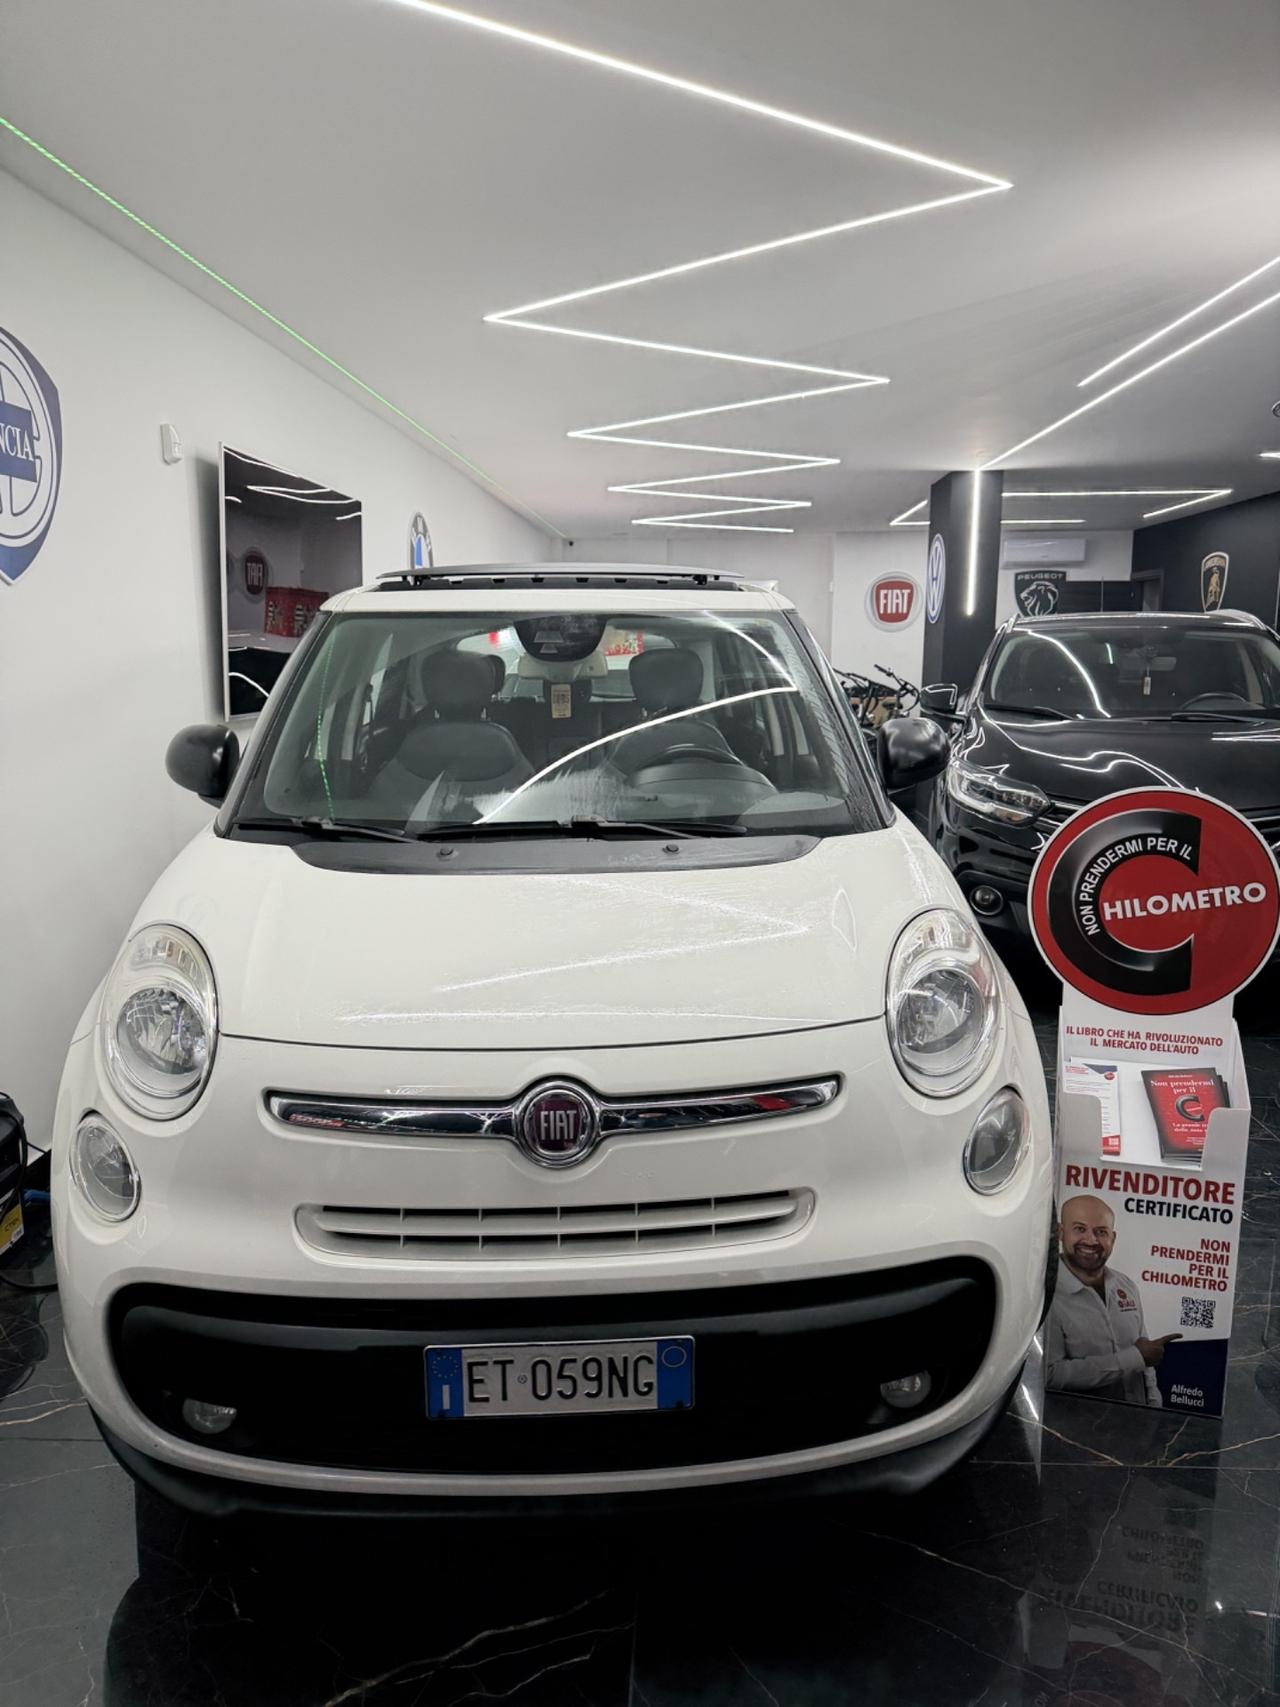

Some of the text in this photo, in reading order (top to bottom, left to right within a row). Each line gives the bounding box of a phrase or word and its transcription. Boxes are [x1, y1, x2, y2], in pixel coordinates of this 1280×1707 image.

[880, 589, 911, 614] FIAT
[1079, 837, 1193, 936] NON PRENDERMI PER IL
[1066, 1026, 1223, 1047] IL LIBRO CHE HA RIVOLUZIONATO
[1090, 1038, 1199, 1055] IL MERCATO DELL'AUTO
[541, 1110, 577, 1140] FIAT
[1065, 1165, 1236, 1205] RIVENDITORE
[1124, 1198, 1233, 1224] CERTIFICATO
[1151, 1246, 1230, 1266] PRENDERMI
[1200, 1239, 1231, 1253] NON
[1141, 1271, 1228, 1292] CHILOMETRO
[1189, 1265, 1229, 1279] PER IL
[467, 1355, 655, 1403] ET 059NG
[1171, 1384, 1204, 1397] Alfredo
[1171, 1395, 1205, 1408] Bellucci
